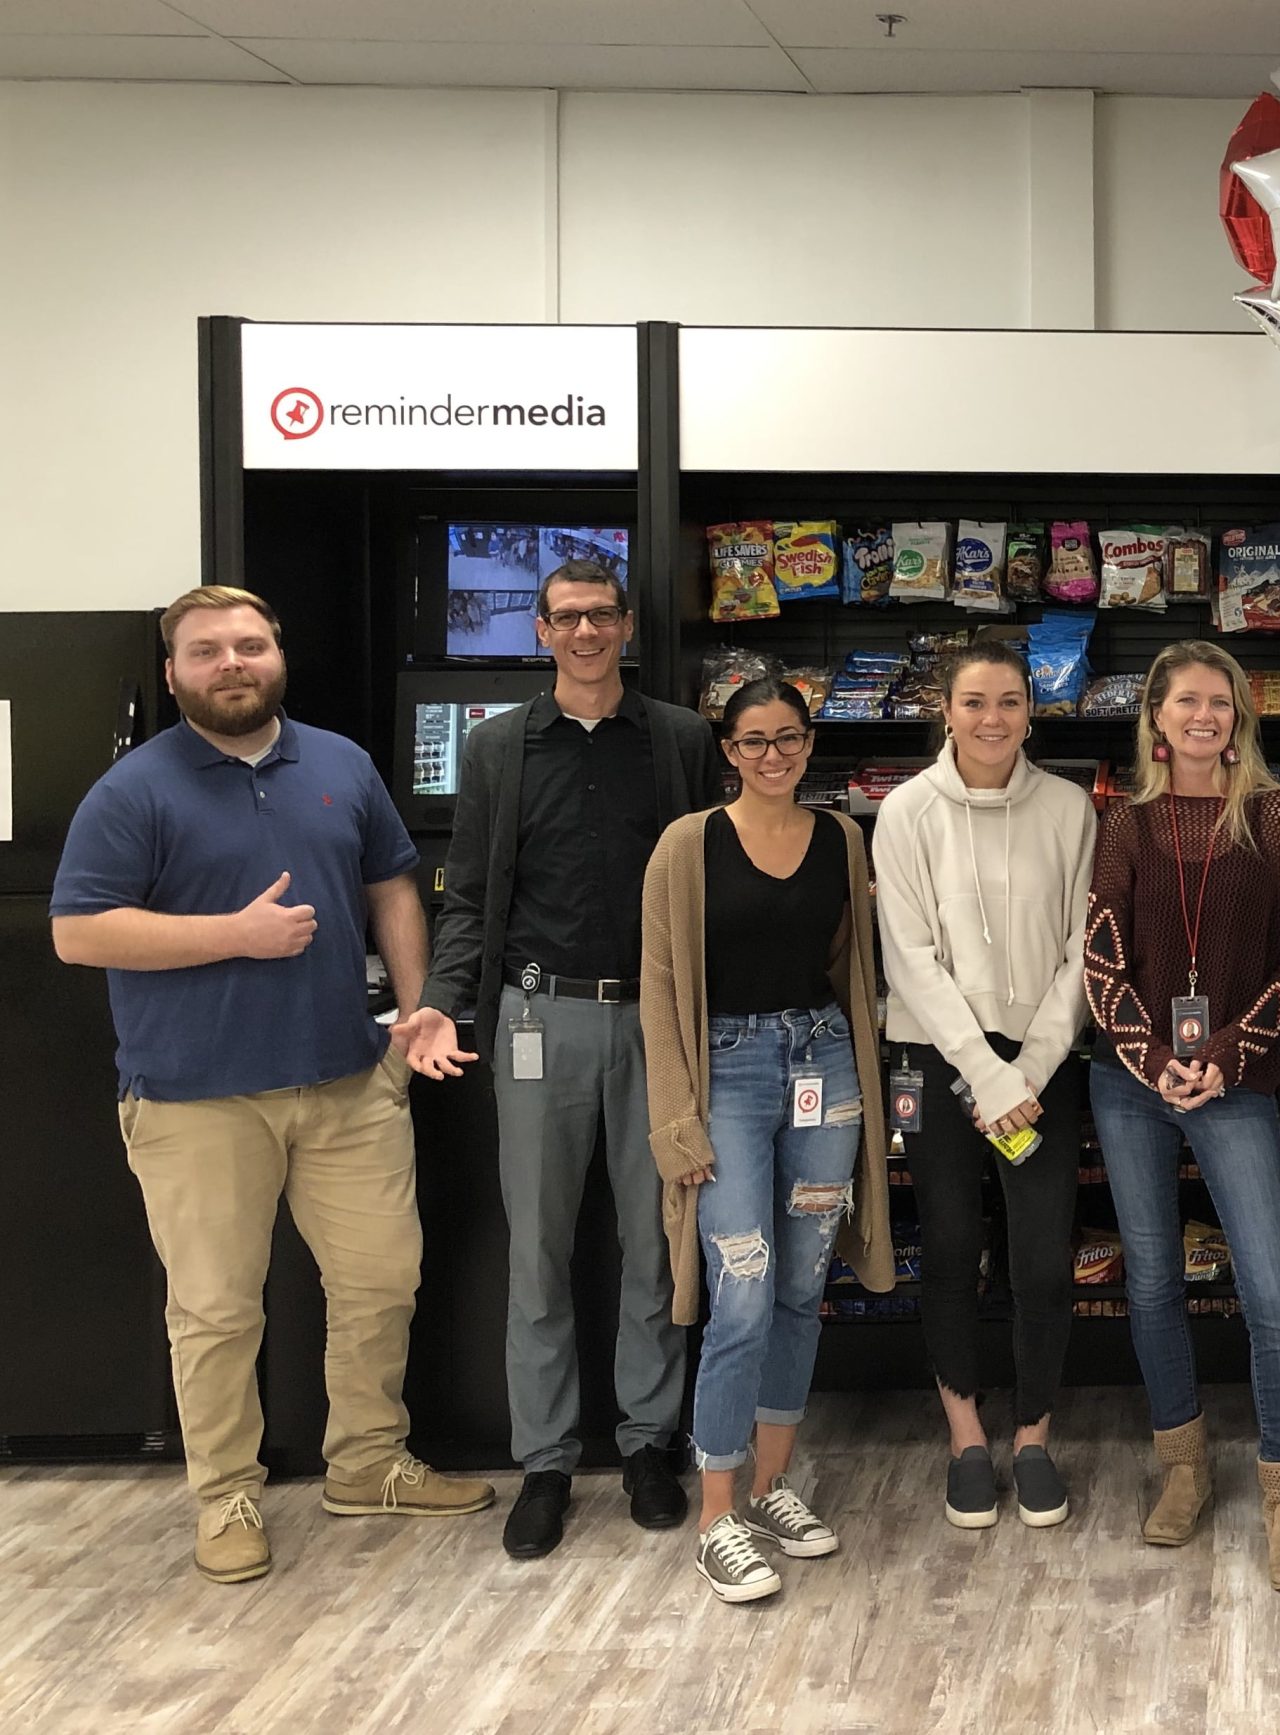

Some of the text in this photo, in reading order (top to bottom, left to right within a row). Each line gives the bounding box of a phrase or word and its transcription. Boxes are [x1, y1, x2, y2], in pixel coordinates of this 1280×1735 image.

[330, 394, 606, 427] remindermedia
[713, 543, 768, 558] LIFE SAVERS
[1103, 538, 1164, 558] Combos
[776, 549, 833, 570] Swedish
[791, 561, 822, 577] Fish
[1094, 688, 1137, 703] FEDERAL
[1085, 703, 1142, 717] SOFT PRETZE
[1078, 1246, 1114, 1268] Fritos
[1190, 1248, 1225, 1265] Fritos
